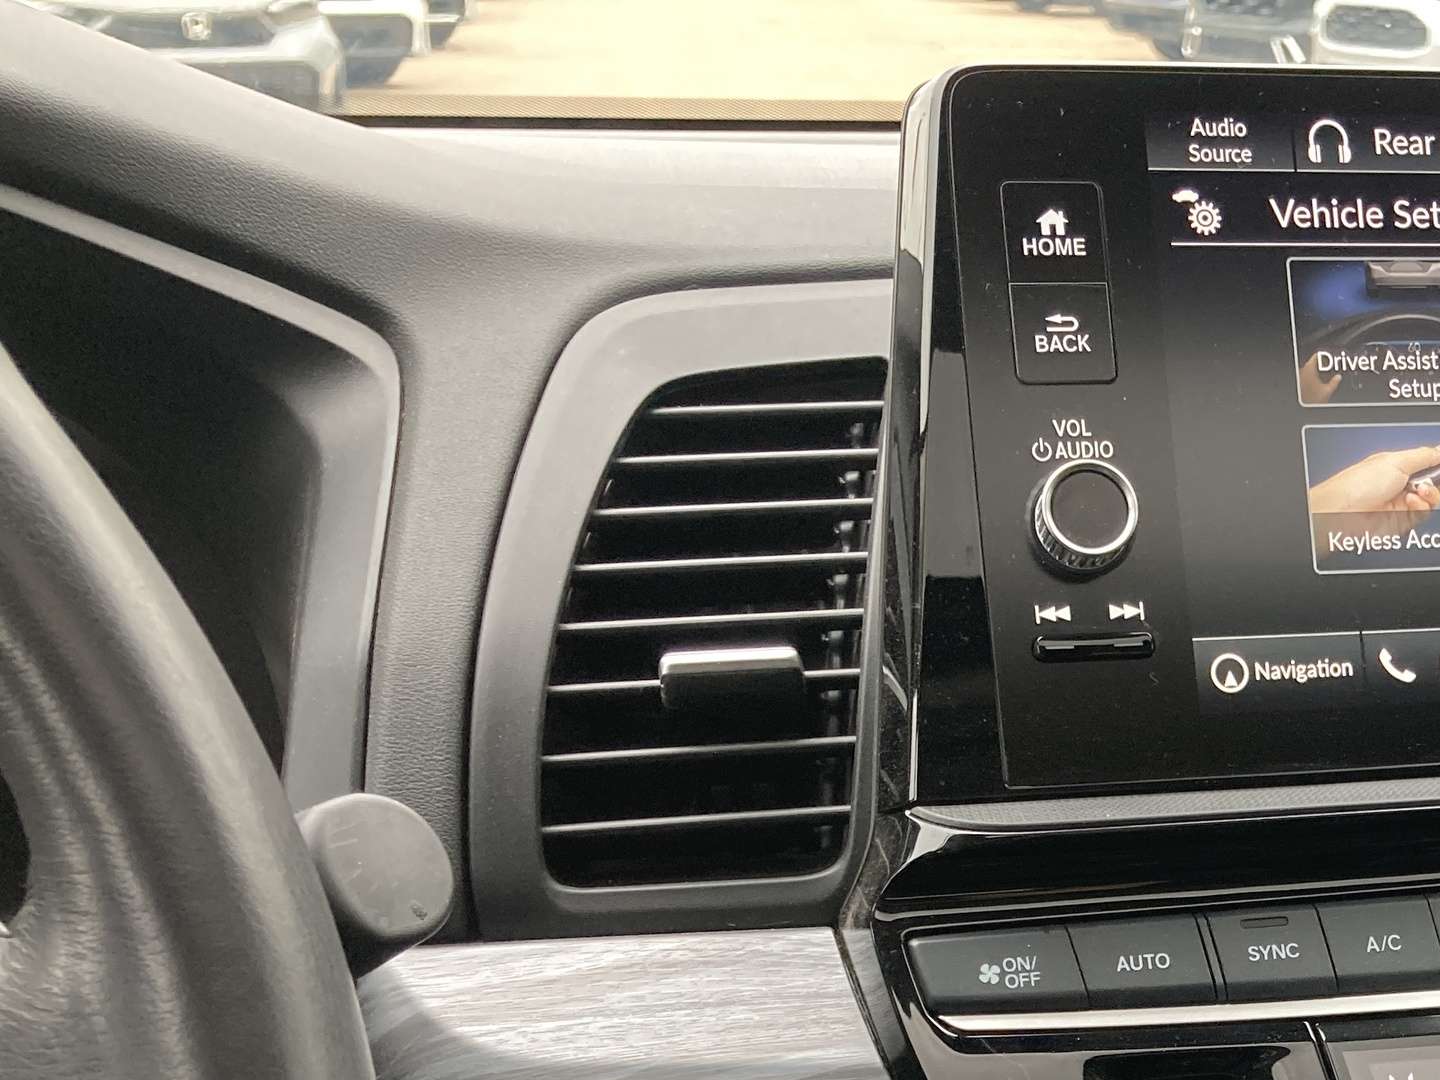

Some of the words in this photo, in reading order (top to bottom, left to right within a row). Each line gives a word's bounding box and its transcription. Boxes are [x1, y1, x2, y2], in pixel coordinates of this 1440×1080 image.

[1190, 119, 1247, 138] Audio
[1374, 129, 1436, 156] Rear
[1188, 143, 1252, 164] Source
[1269, 199, 1384, 229] Vehicle
[1023, 237, 1086, 256] HOME
[1034, 334, 1091, 353] BACK
[1316, 351, 1377, 371] Driver
[1382, 351, 1439, 370] Assist
[1053, 419, 1092, 437] VOL
[1055, 440, 1114, 459] AUDIO
[1328, 530, 1402, 552] Keyless
[1254, 658, 1353, 682] Navigation
[1248, 942, 1300, 962] SYNC
[1366, 934, 1402, 953] A/C
[1002, 955, 1037, 973] ON/
[1117, 952, 1171, 971] AUTO
[1004, 970, 1042, 990] OFF
